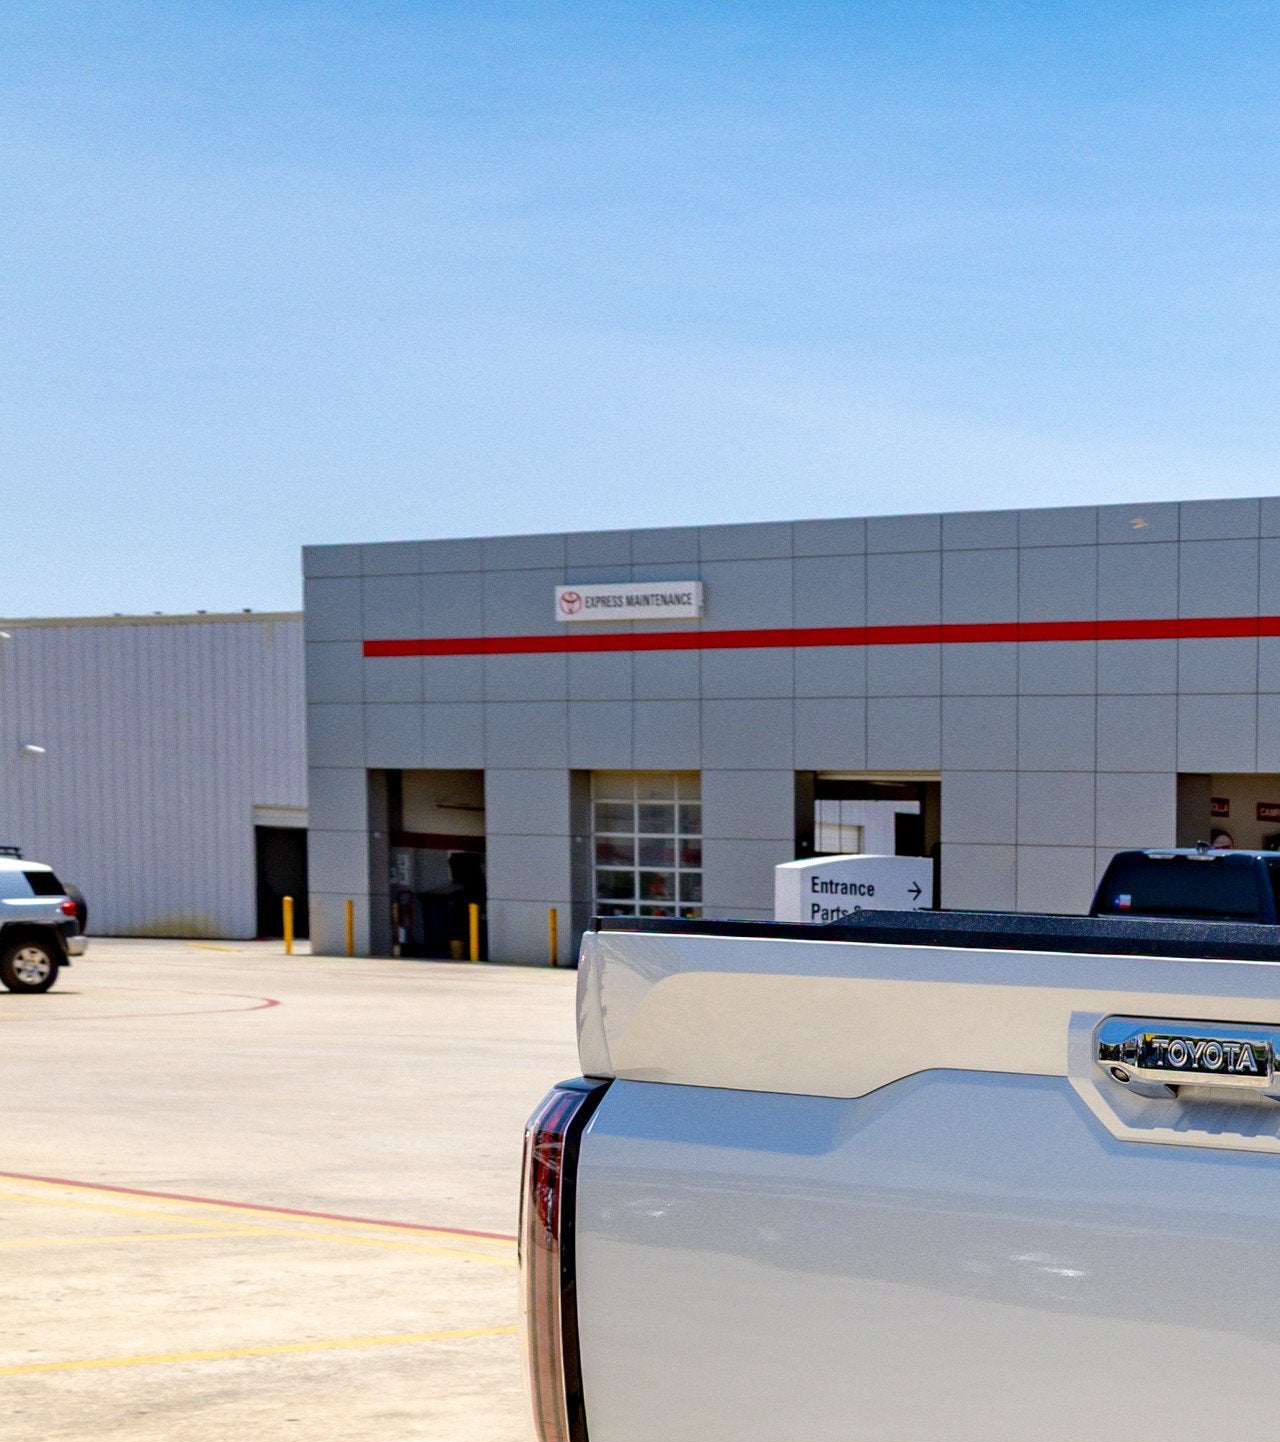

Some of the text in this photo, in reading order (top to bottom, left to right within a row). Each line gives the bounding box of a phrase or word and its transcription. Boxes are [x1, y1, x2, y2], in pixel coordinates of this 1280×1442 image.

[585, 592, 693, 608] EXPRESS MAINTENANCE
[811, 876, 875, 897] Entrance
[811, 903, 849, 921] Parts
[1152, 1038, 1258, 1072] TOYOTA
